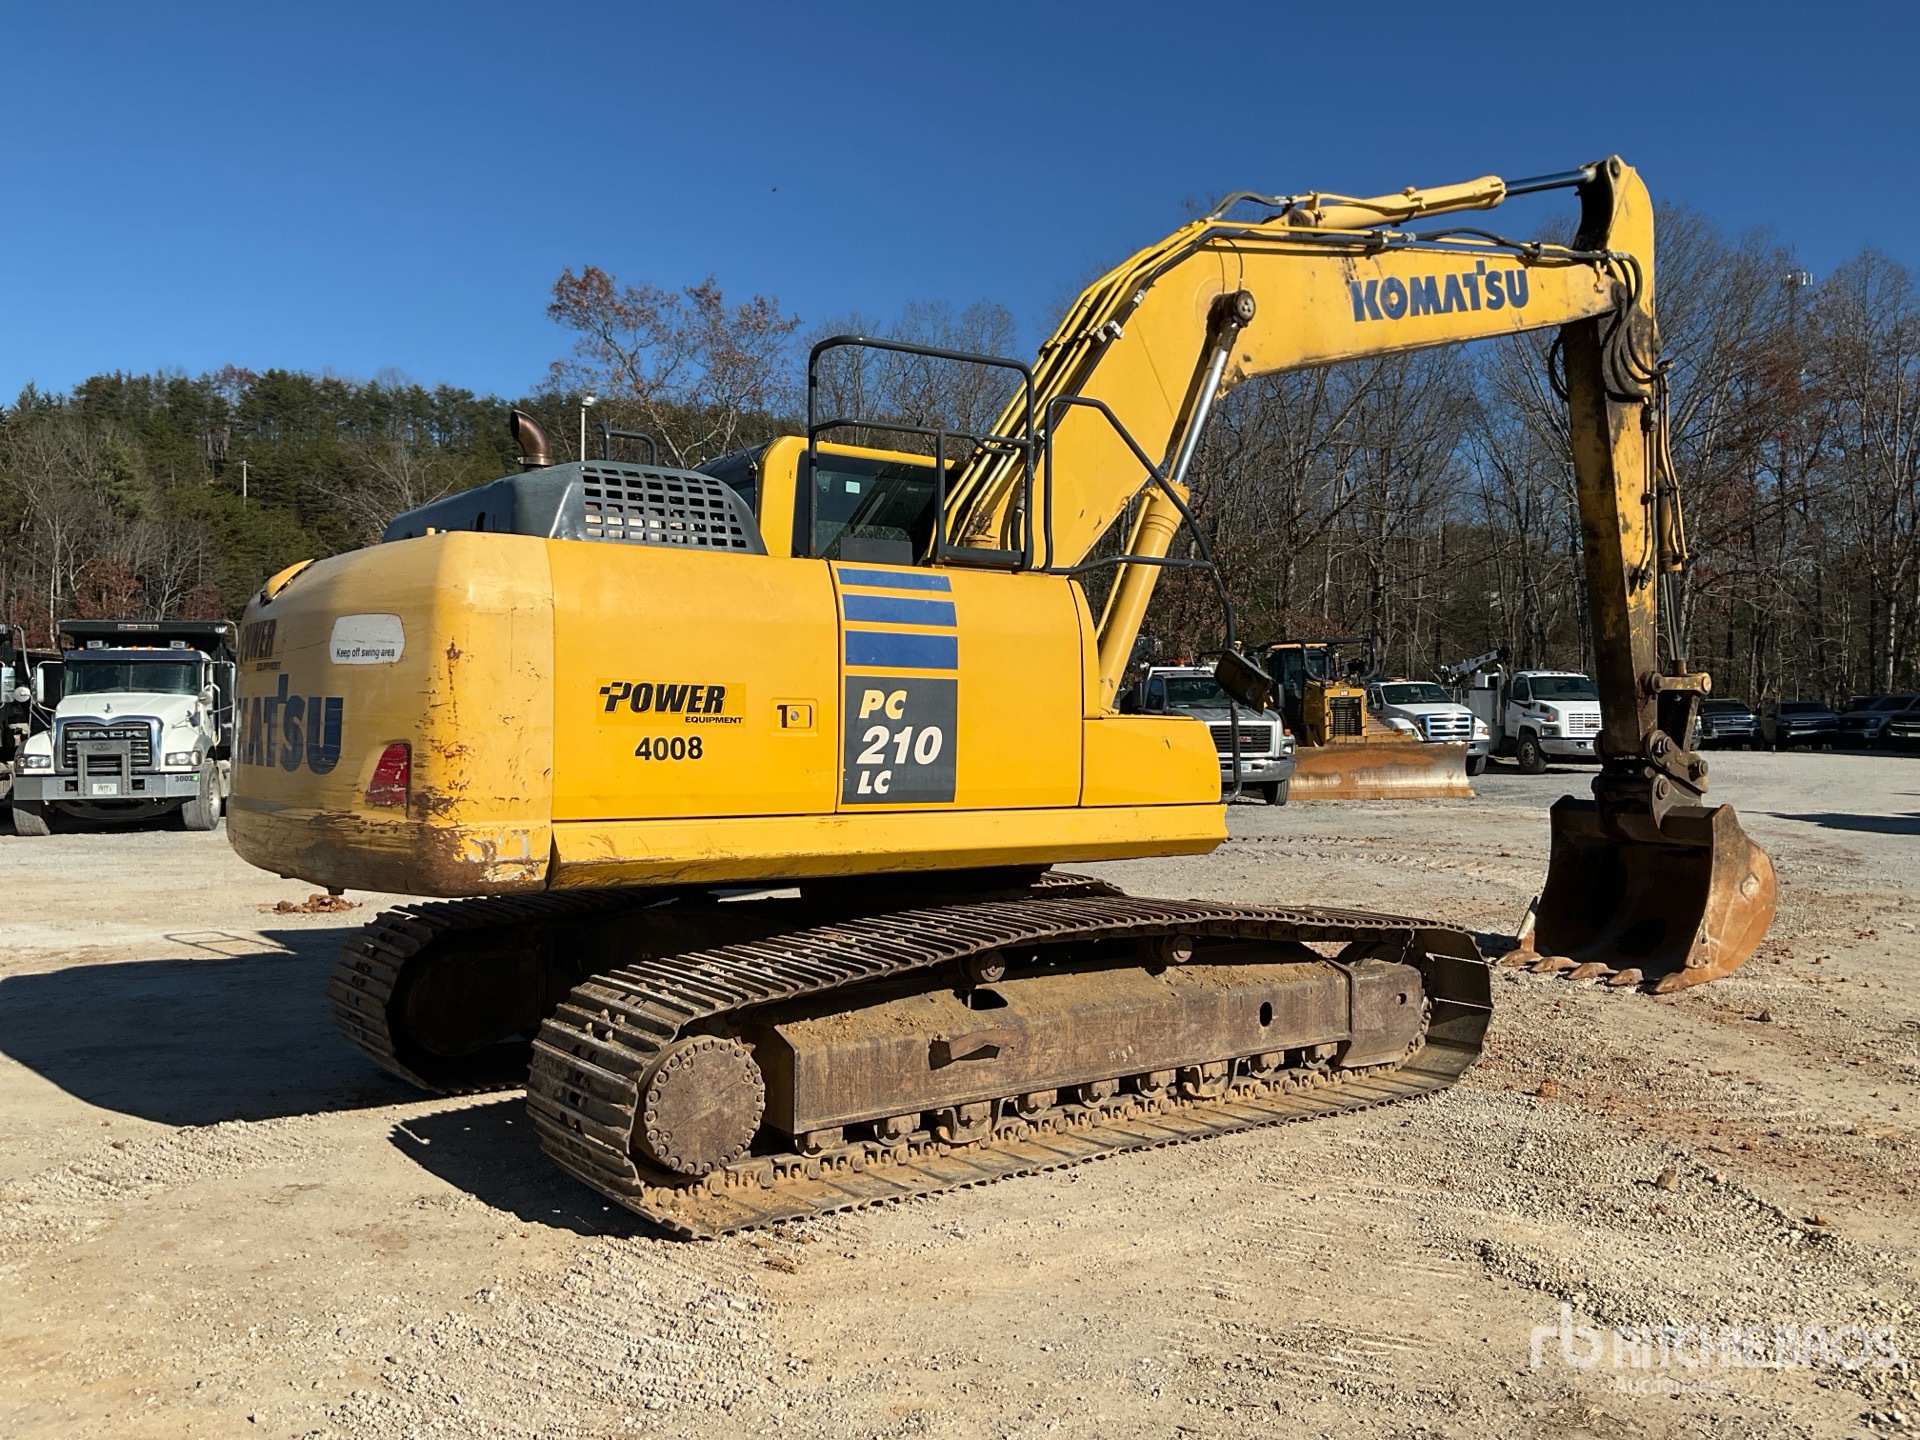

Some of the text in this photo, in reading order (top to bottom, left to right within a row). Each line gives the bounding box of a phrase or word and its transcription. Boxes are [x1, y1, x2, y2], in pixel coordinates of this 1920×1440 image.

[1350, 260, 1529, 322] KOMATSU
[336, 646, 395, 659] Keep off swing area
[599, 681, 727, 714] POWER
[859, 689, 907, 720] PC
[684, 715, 743, 724] EQUIPMENT
[70, 730, 142, 739] MACK
[856, 725, 943, 765] 210
[634, 736, 703, 761] 4008
[857, 769, 892, 794] LC
